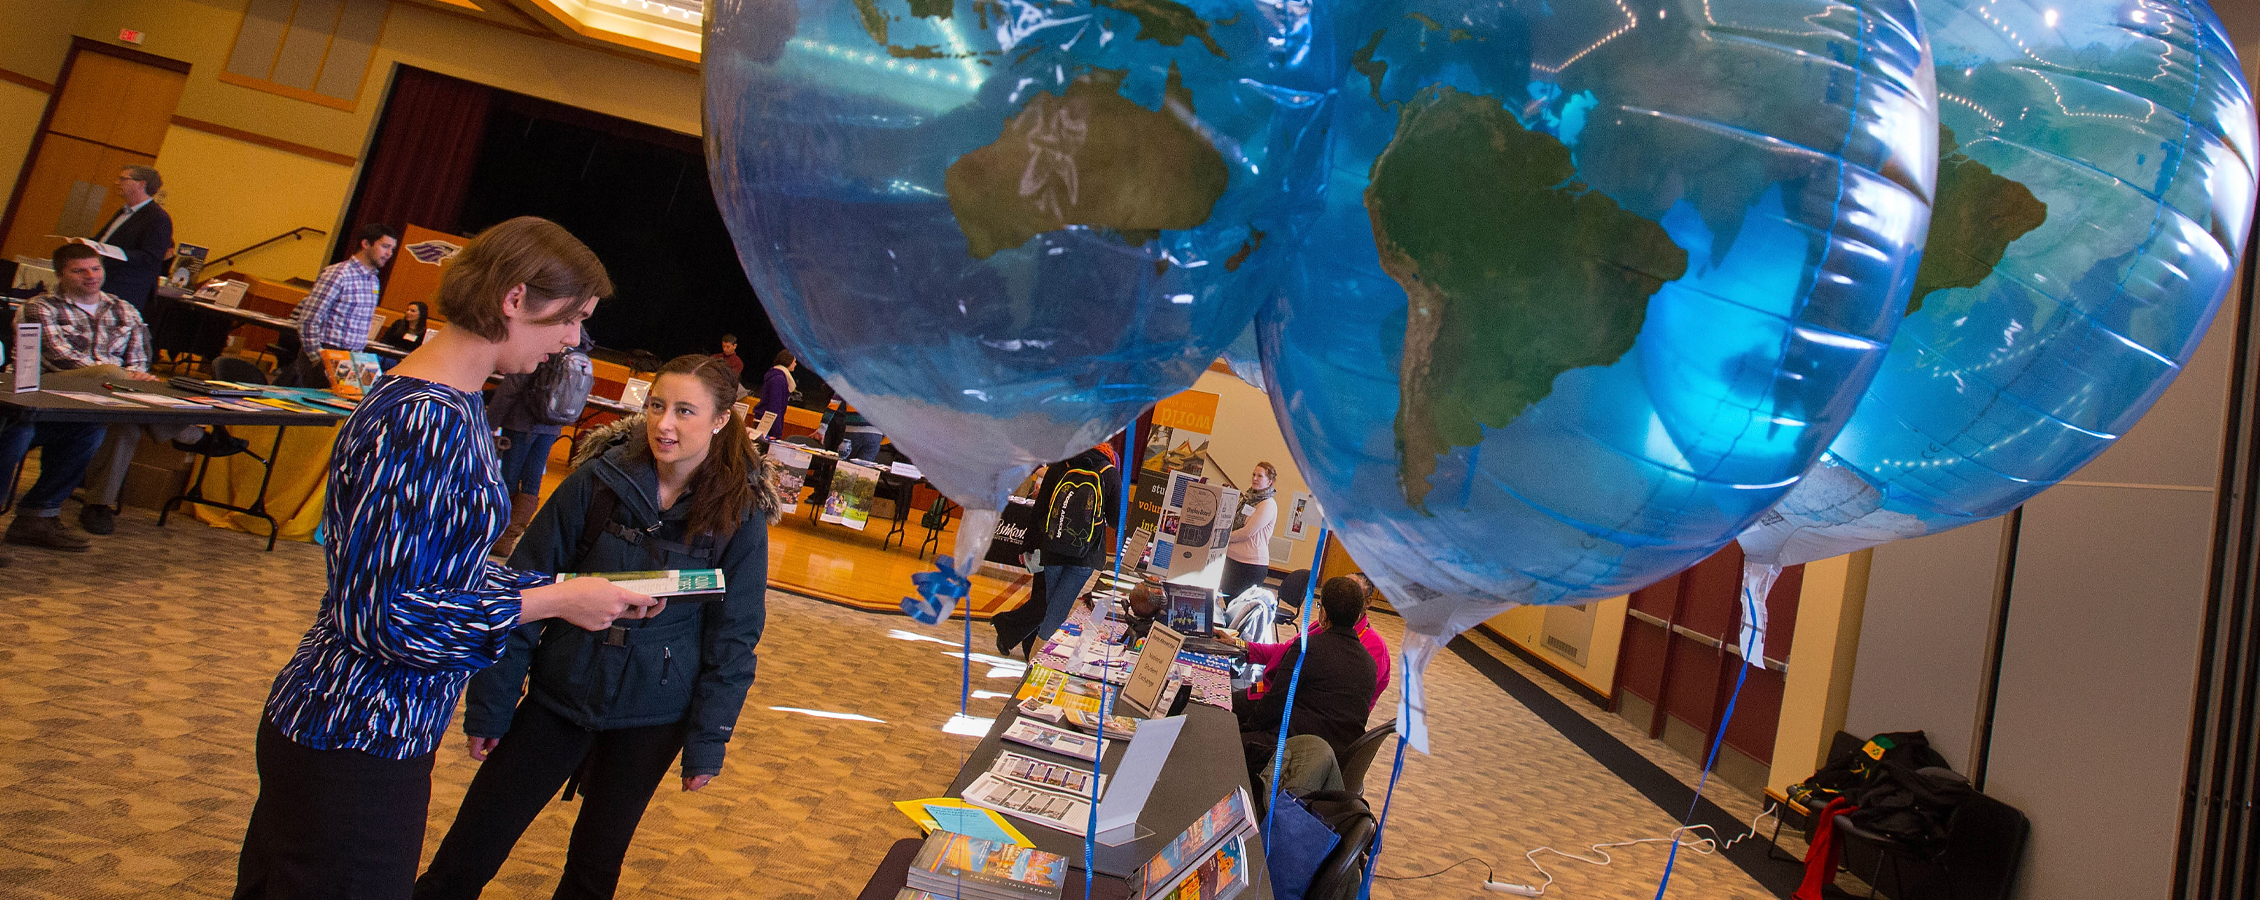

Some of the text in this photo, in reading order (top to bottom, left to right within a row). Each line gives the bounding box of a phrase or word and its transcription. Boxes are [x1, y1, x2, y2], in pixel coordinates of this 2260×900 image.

[1160, 407, 1210, 430] world
[1056, 491, 1074, 538] UNDER ARMOUR
[1149, 652, 1164, 664] National
[1144, 662, 1158, 675] Student
[1138, 673, 1154, 687] Exchange
[970, 874, 1052, 895] FRANCE ITALY SPAIN
